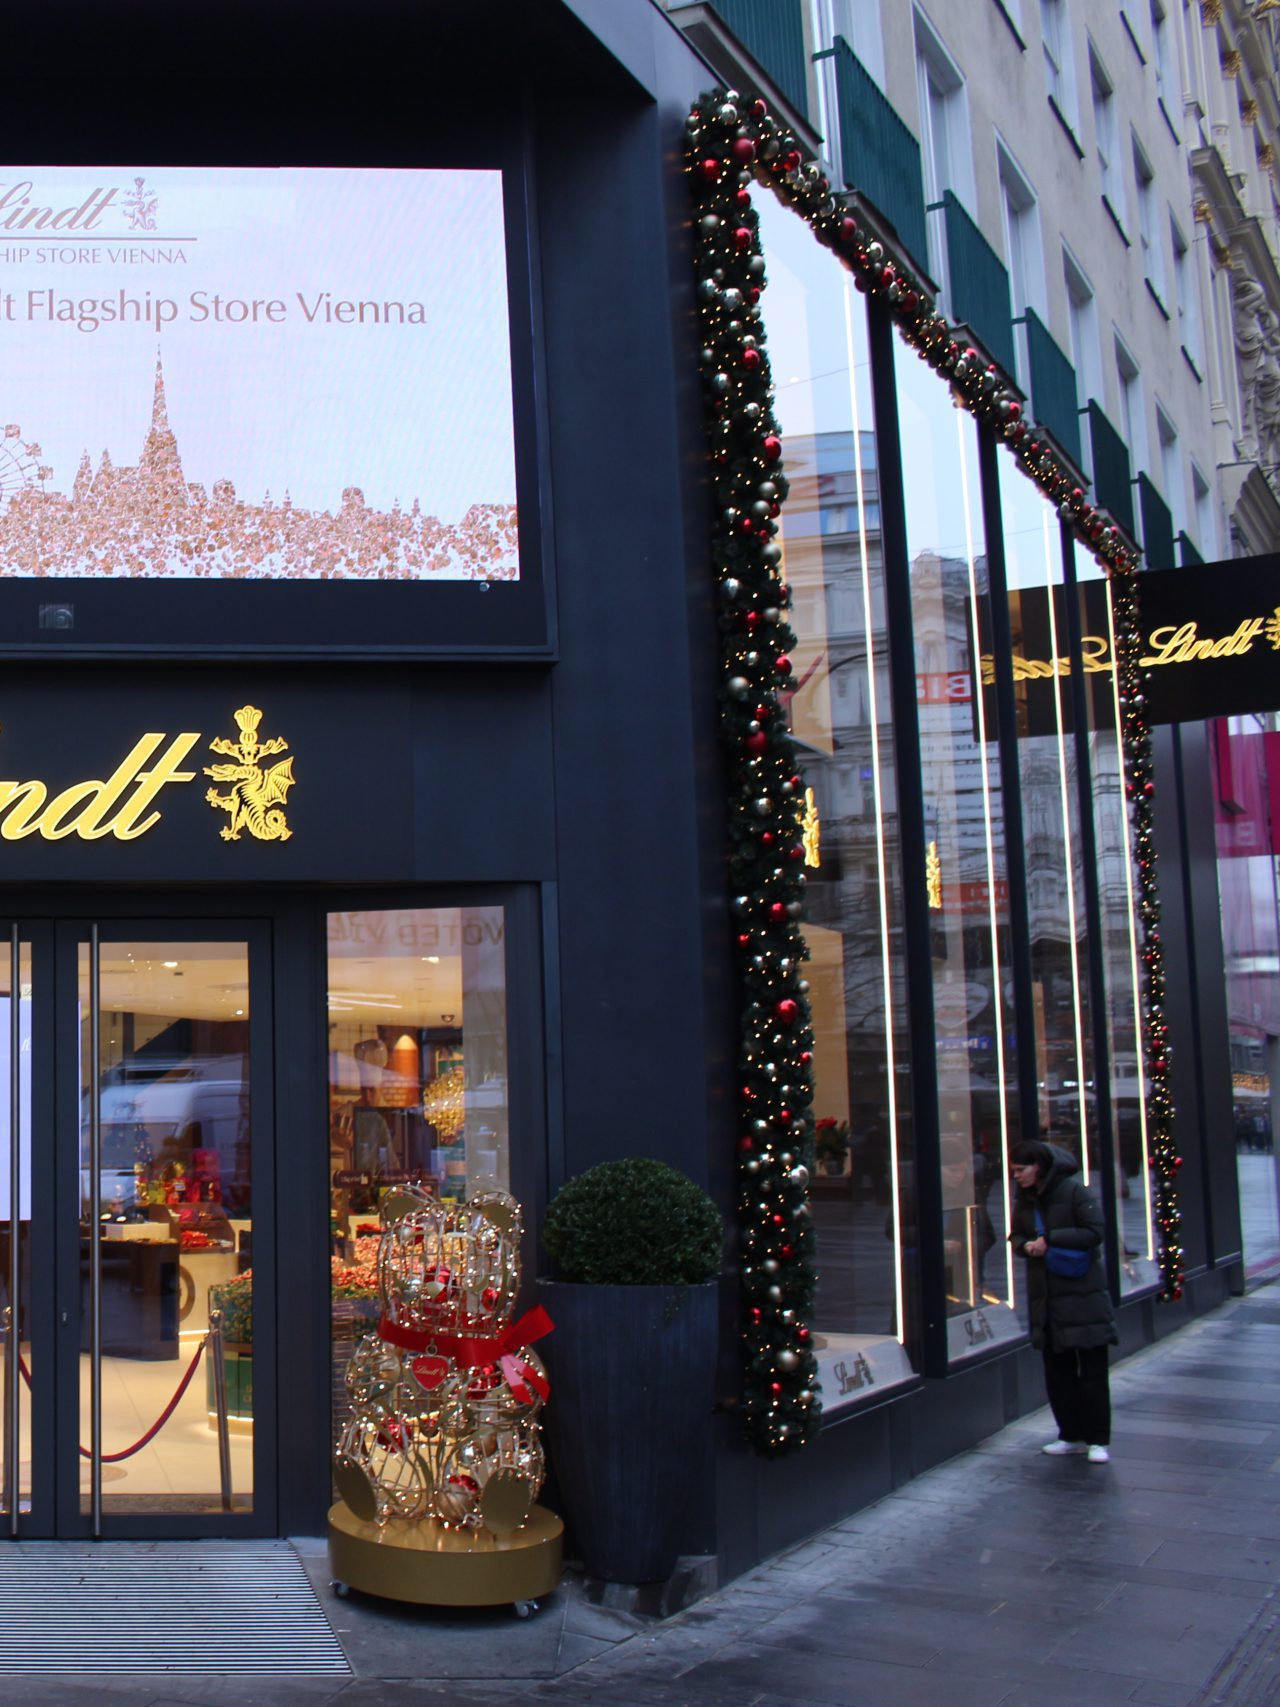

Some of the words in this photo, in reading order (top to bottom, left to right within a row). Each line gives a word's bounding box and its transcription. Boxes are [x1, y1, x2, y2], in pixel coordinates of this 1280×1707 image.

[36, 248, 101, 264] STORE
[107, 249, 188, 264] VIENNA
[27, 288, 179, 333] Flagship
[189, 291, 288, 324] Store
[295, 292, 427, 325] Vienna
[1138, 616, 1264, 668] Lindt
